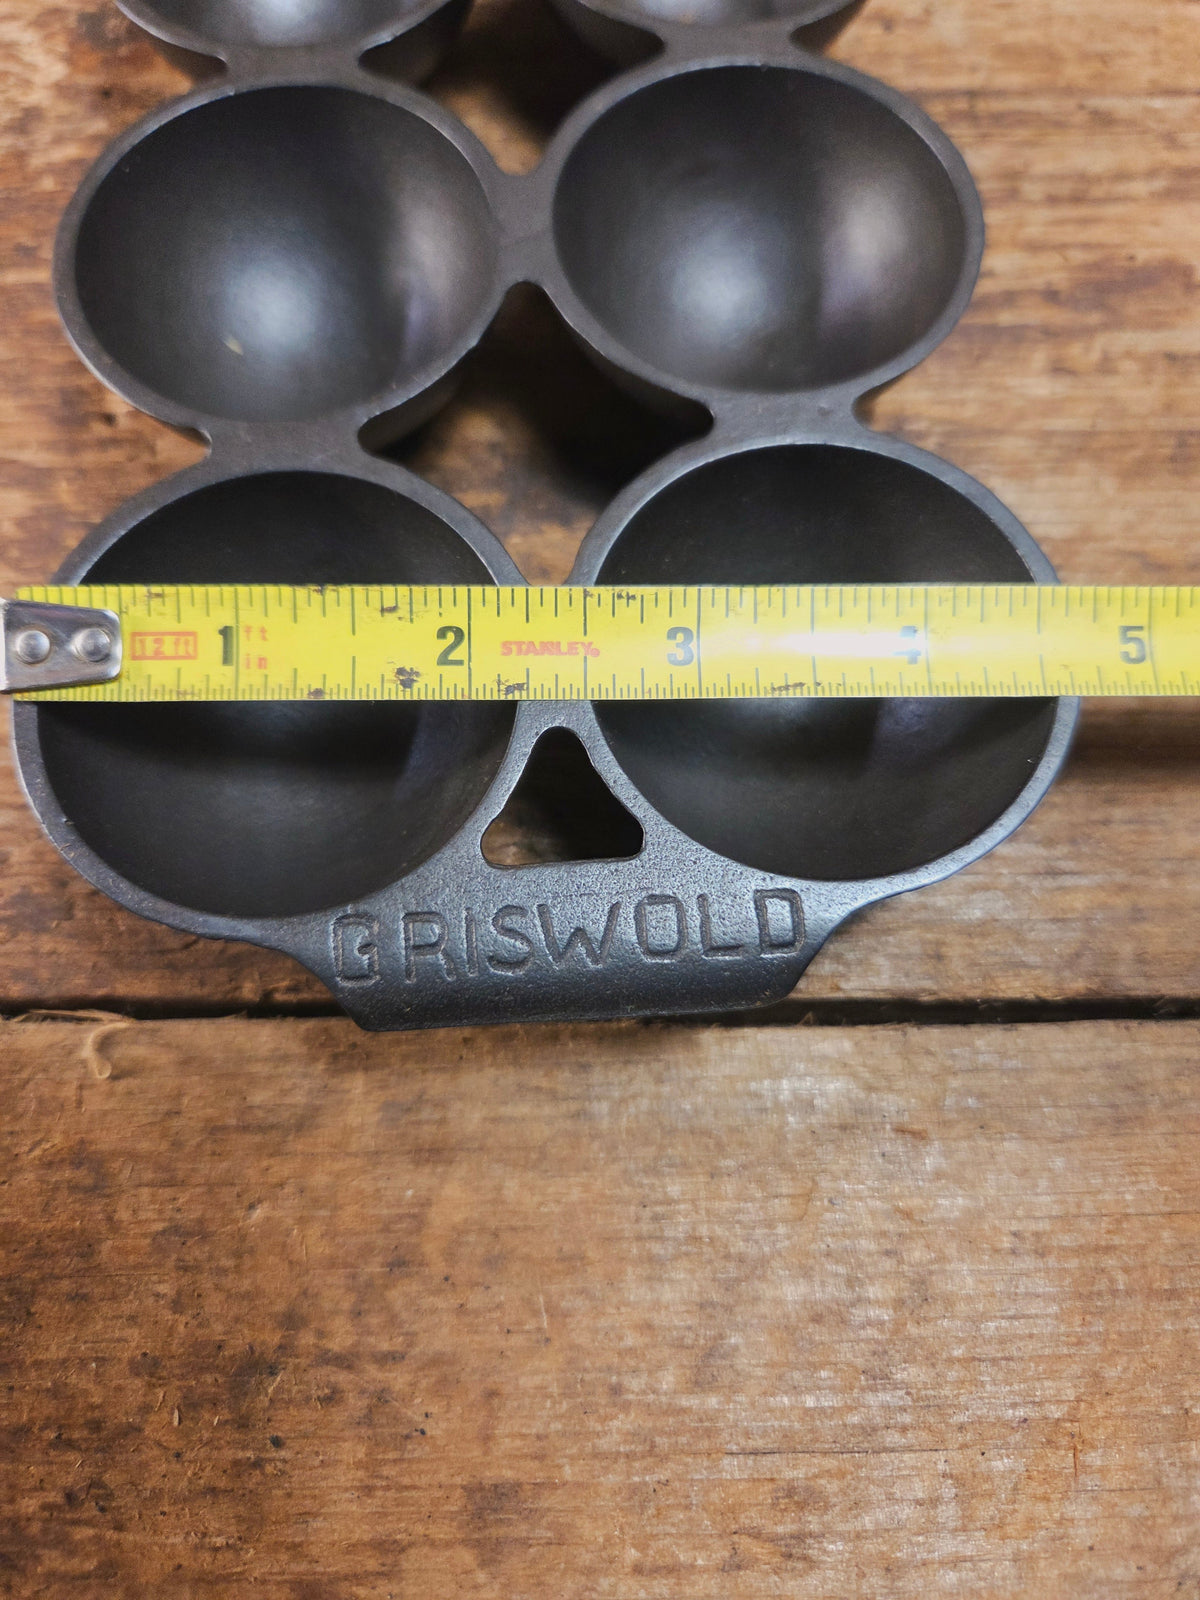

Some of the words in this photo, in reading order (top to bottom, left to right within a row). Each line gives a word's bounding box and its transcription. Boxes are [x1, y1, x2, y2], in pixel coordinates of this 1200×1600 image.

[218, 625, 234, 666] 1
[436, 625, 465, 666] 2
[666, 626, 695, 666] 3
[1118, 625, 1147, 664] 5
[331, 887, 806, 988] GRISWOLD
